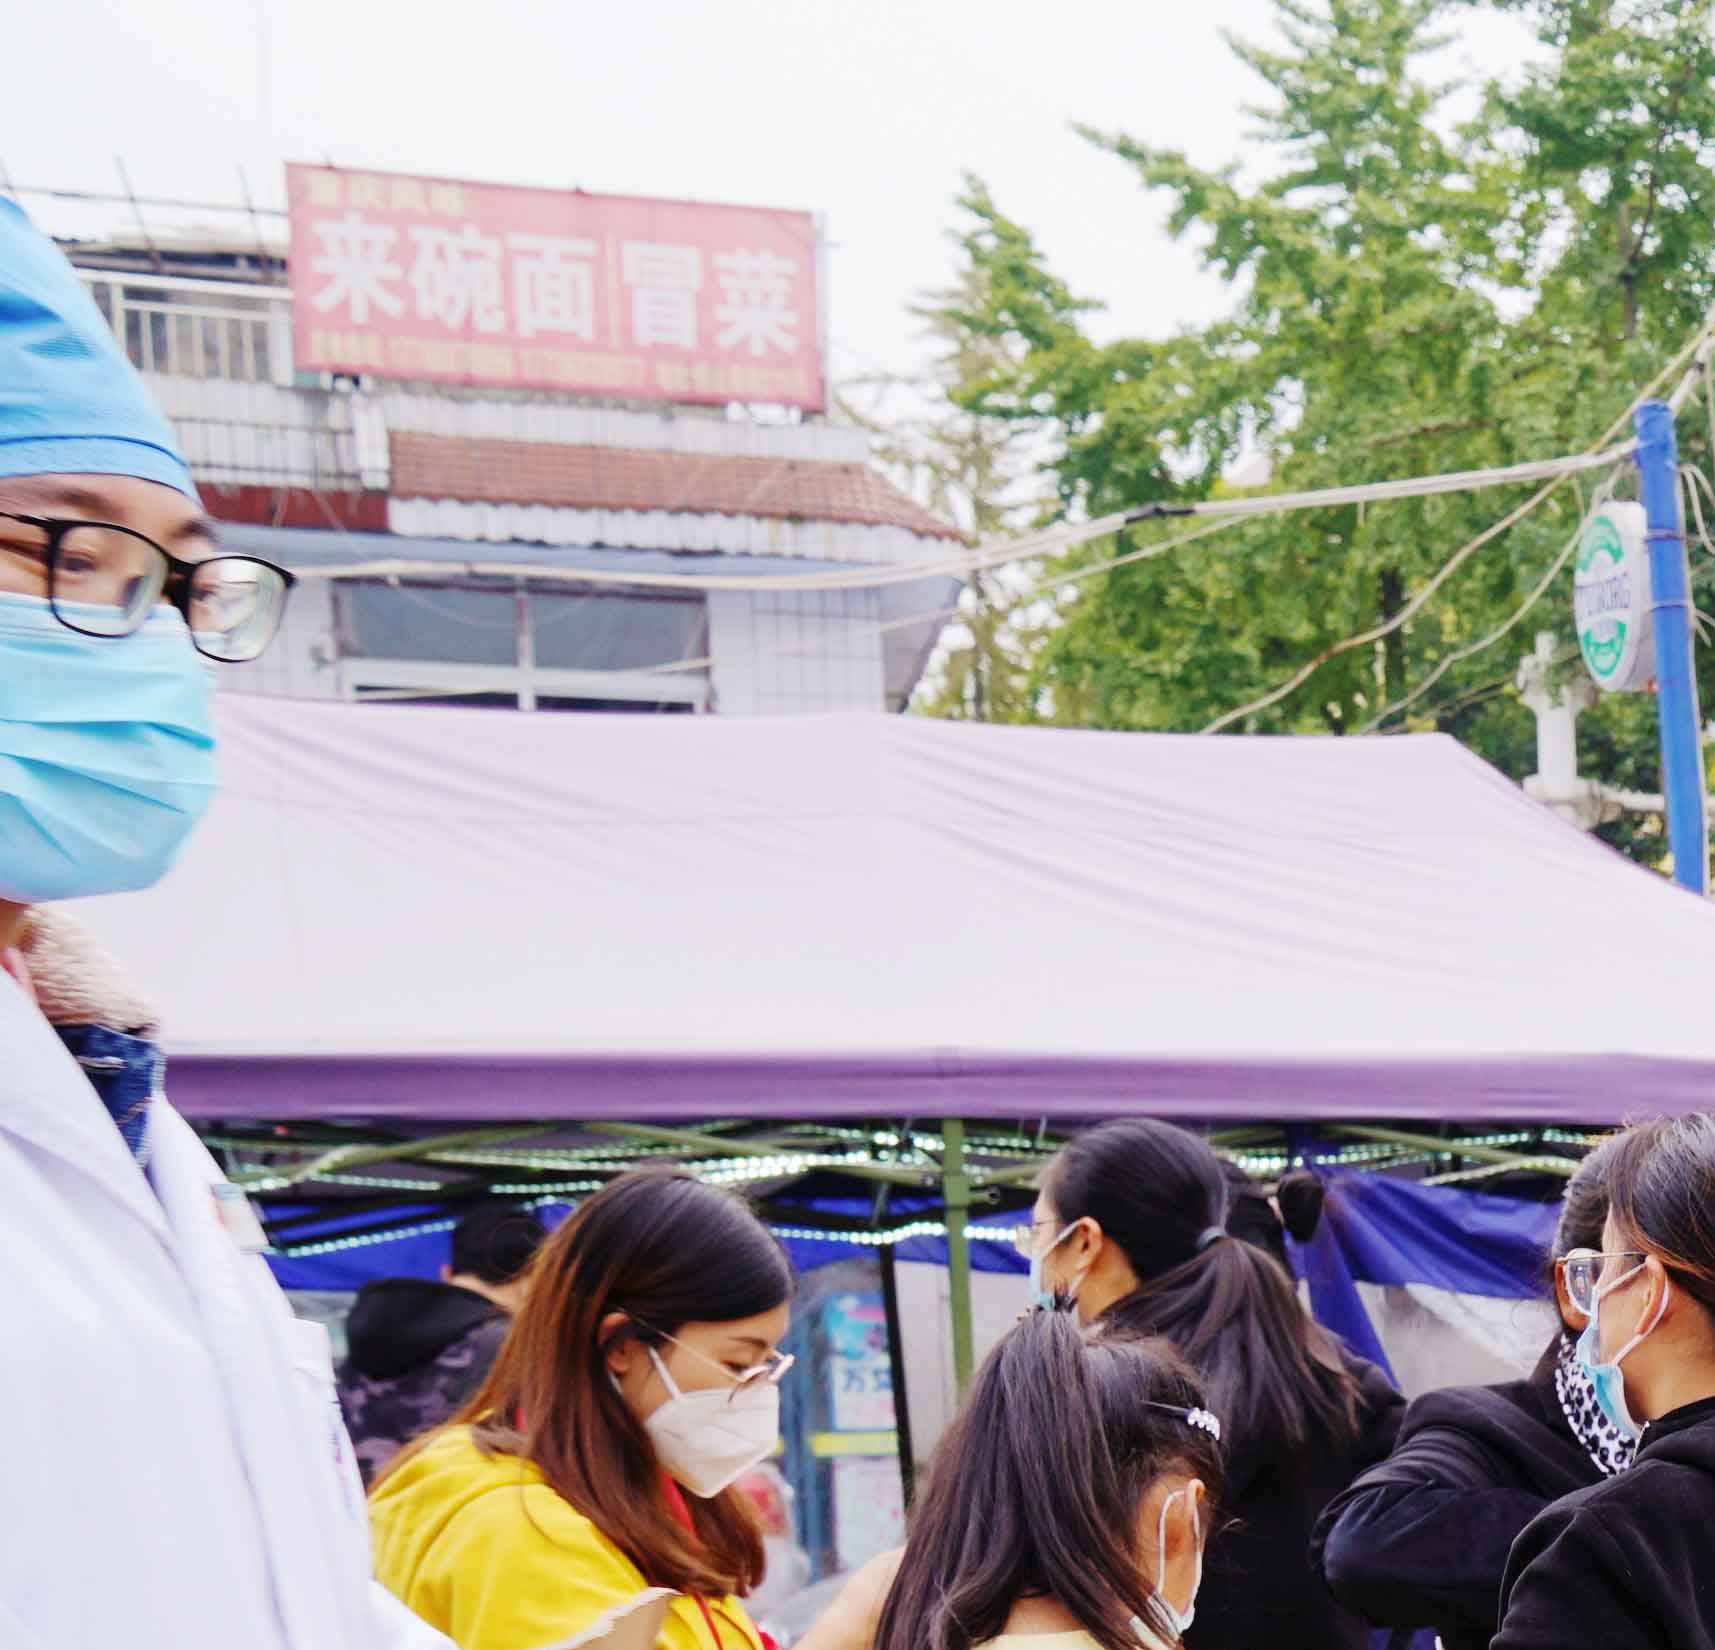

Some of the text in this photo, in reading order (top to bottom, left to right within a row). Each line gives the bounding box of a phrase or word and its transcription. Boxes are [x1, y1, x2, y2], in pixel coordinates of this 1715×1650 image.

[312, 210, 800, 357] 来碗面 冒菜
